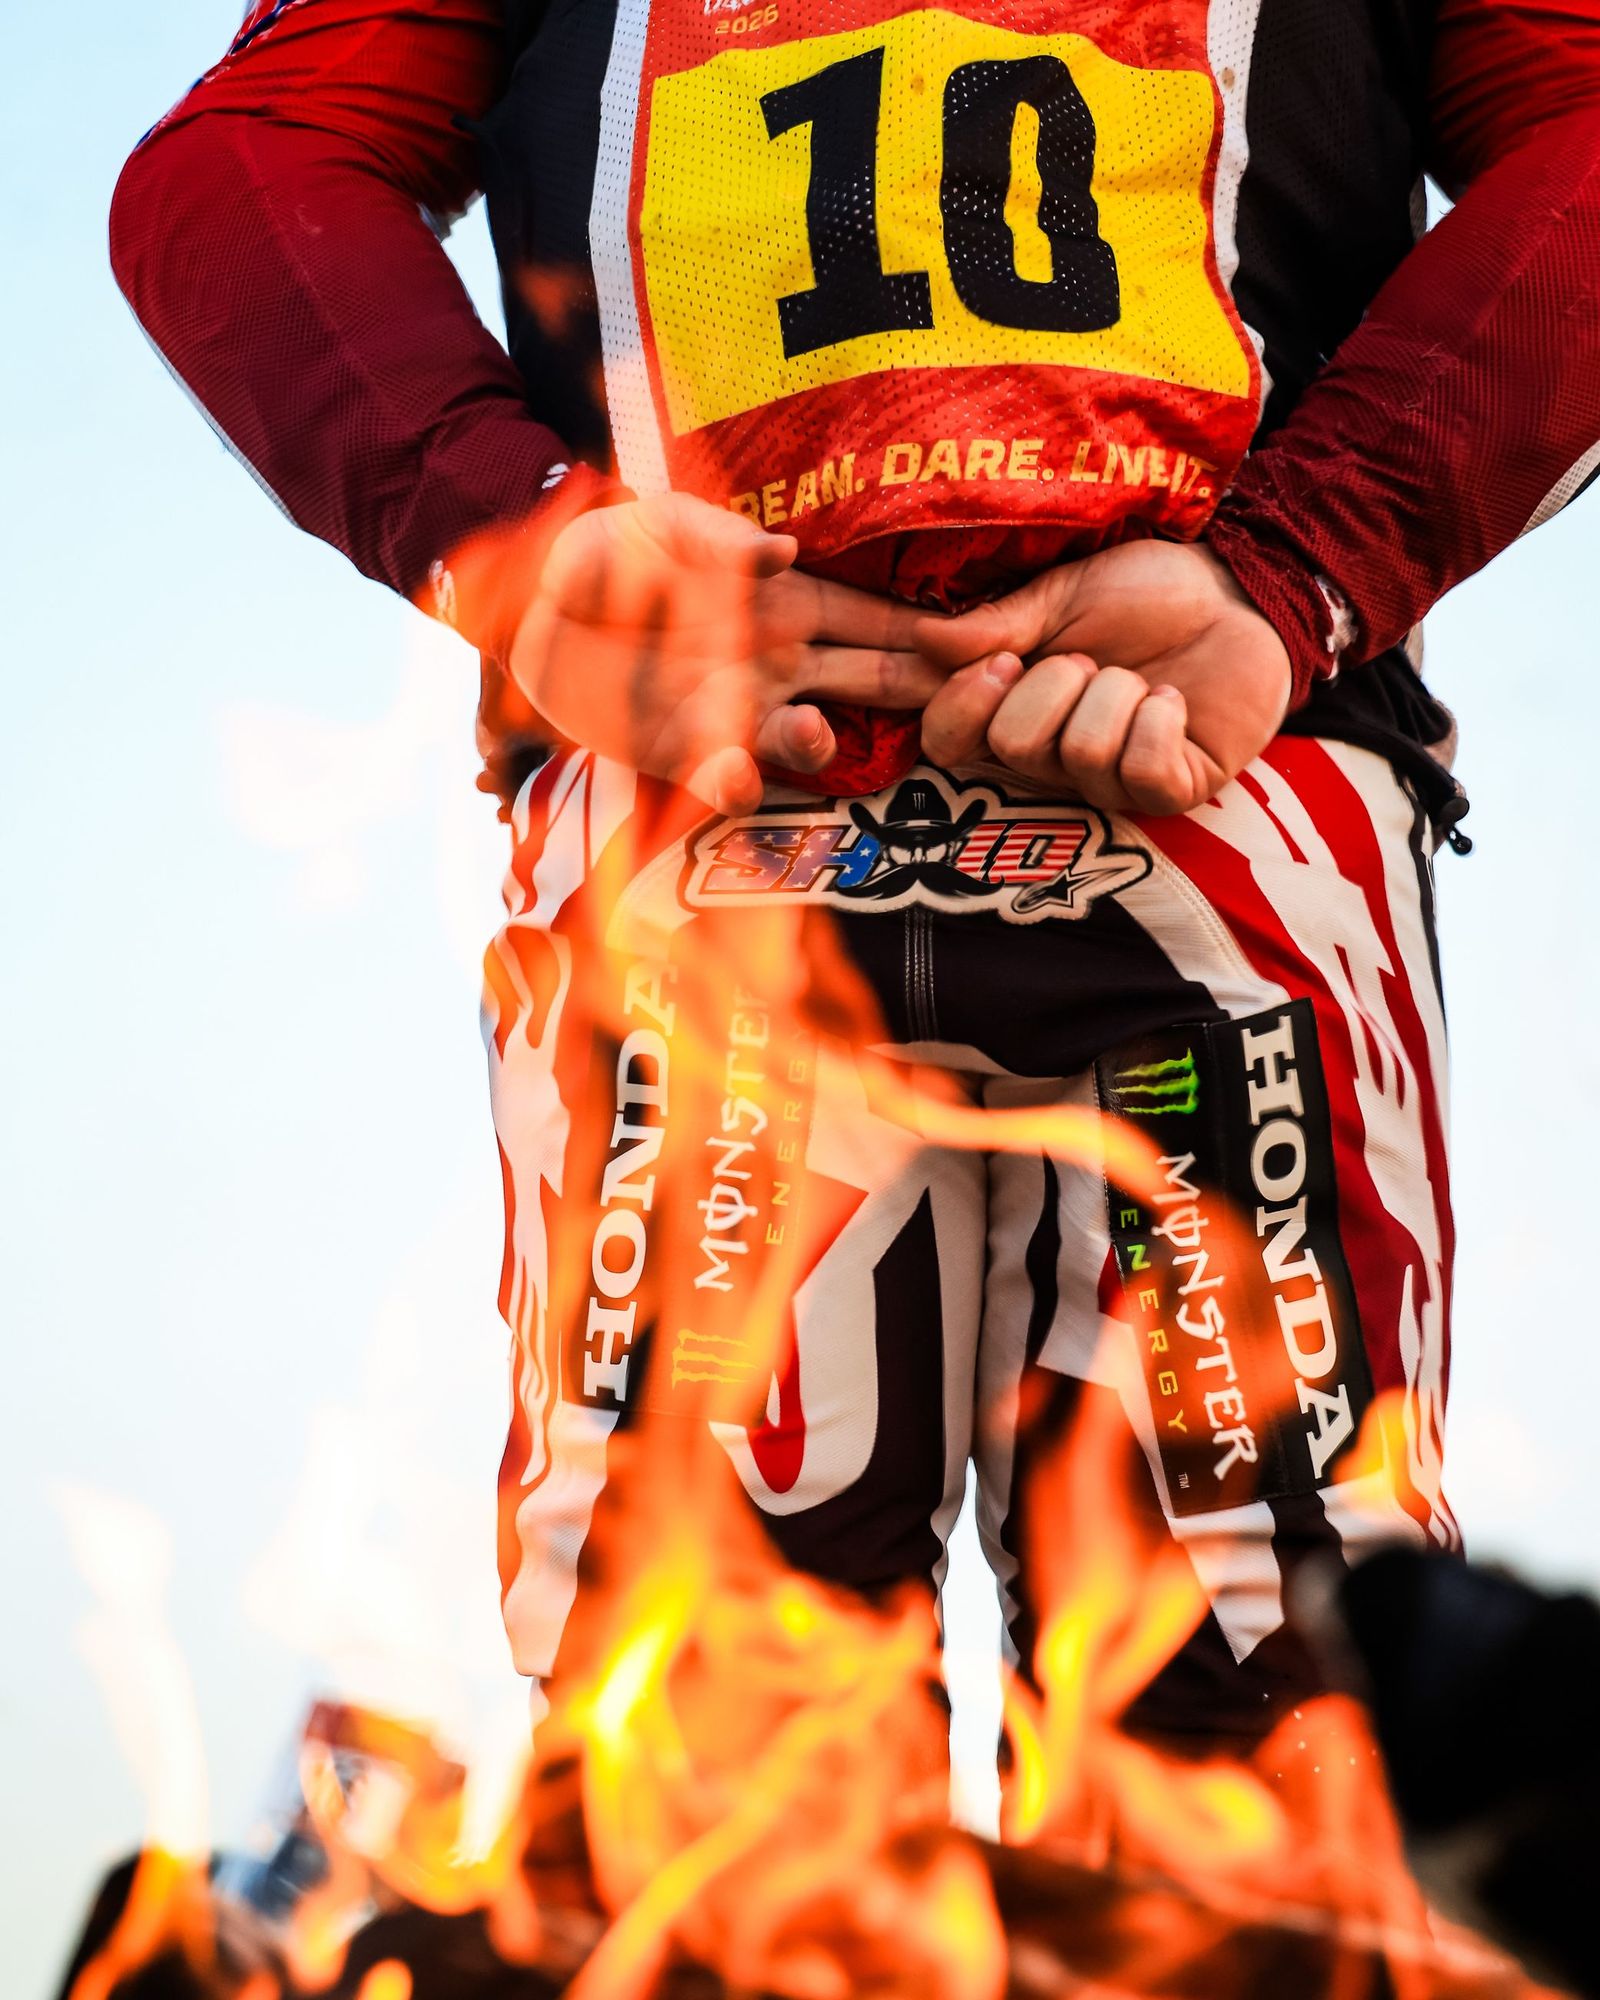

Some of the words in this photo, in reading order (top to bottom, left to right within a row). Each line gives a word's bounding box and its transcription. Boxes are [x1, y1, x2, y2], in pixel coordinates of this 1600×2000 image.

[714, 3, 779, 35] 2026
[759, 45, 1121, 361] 10
[729, 452, 866, 528] REAM.
[879, 438, 1055, 487] DARE.
[583, 961, 679, 1402] HONDA
[765, 1030, 809, 1246] ENERG
[1239, 1014, 1355, 1480] HONDA
[1119, 1208, 1189, 1435] ENERGY
[1150, 1151, 1260, 1481] MONSTER
